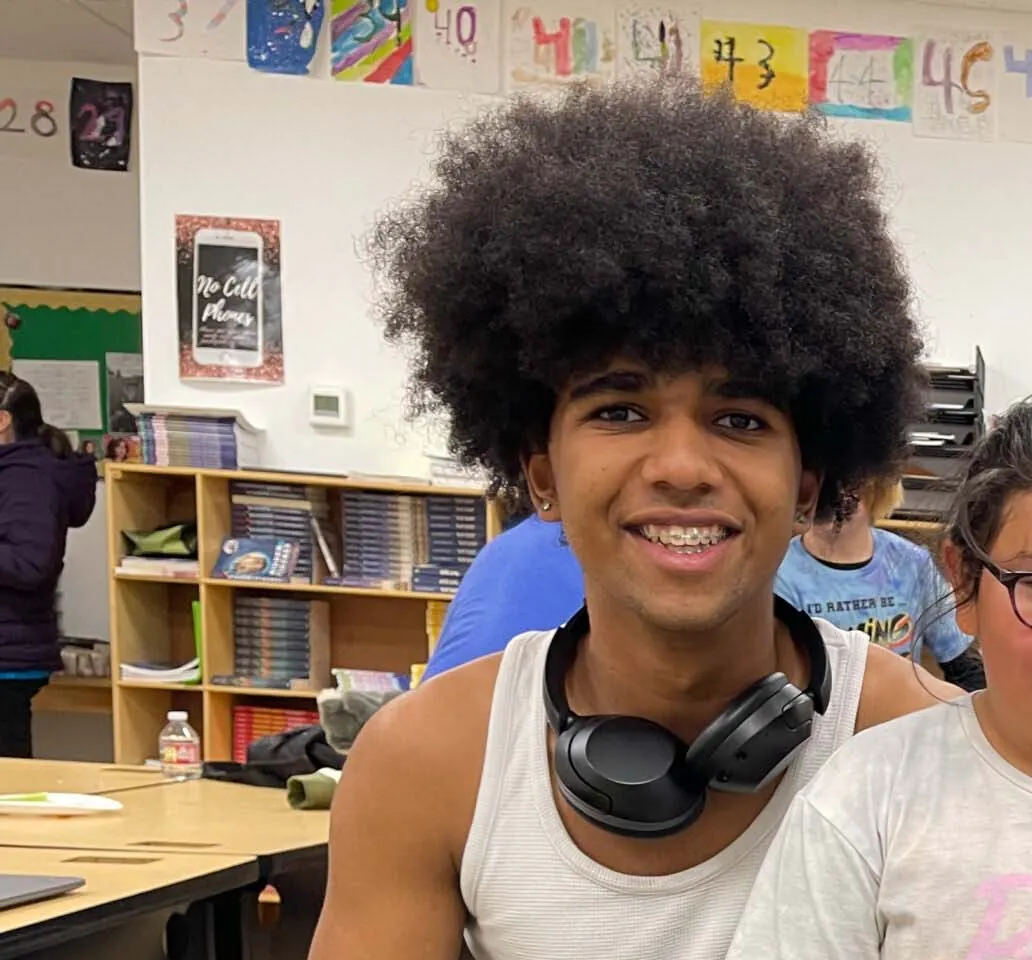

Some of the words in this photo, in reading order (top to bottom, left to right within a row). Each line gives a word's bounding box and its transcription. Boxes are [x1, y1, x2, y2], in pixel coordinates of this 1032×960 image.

[713, 36, 776, 89] 43
[0, 98, 58, 137] 28
[196, 275, 221, 298] No
[827, 598, 878, 612] RATHER
[880, 596, 895, 608] BE
